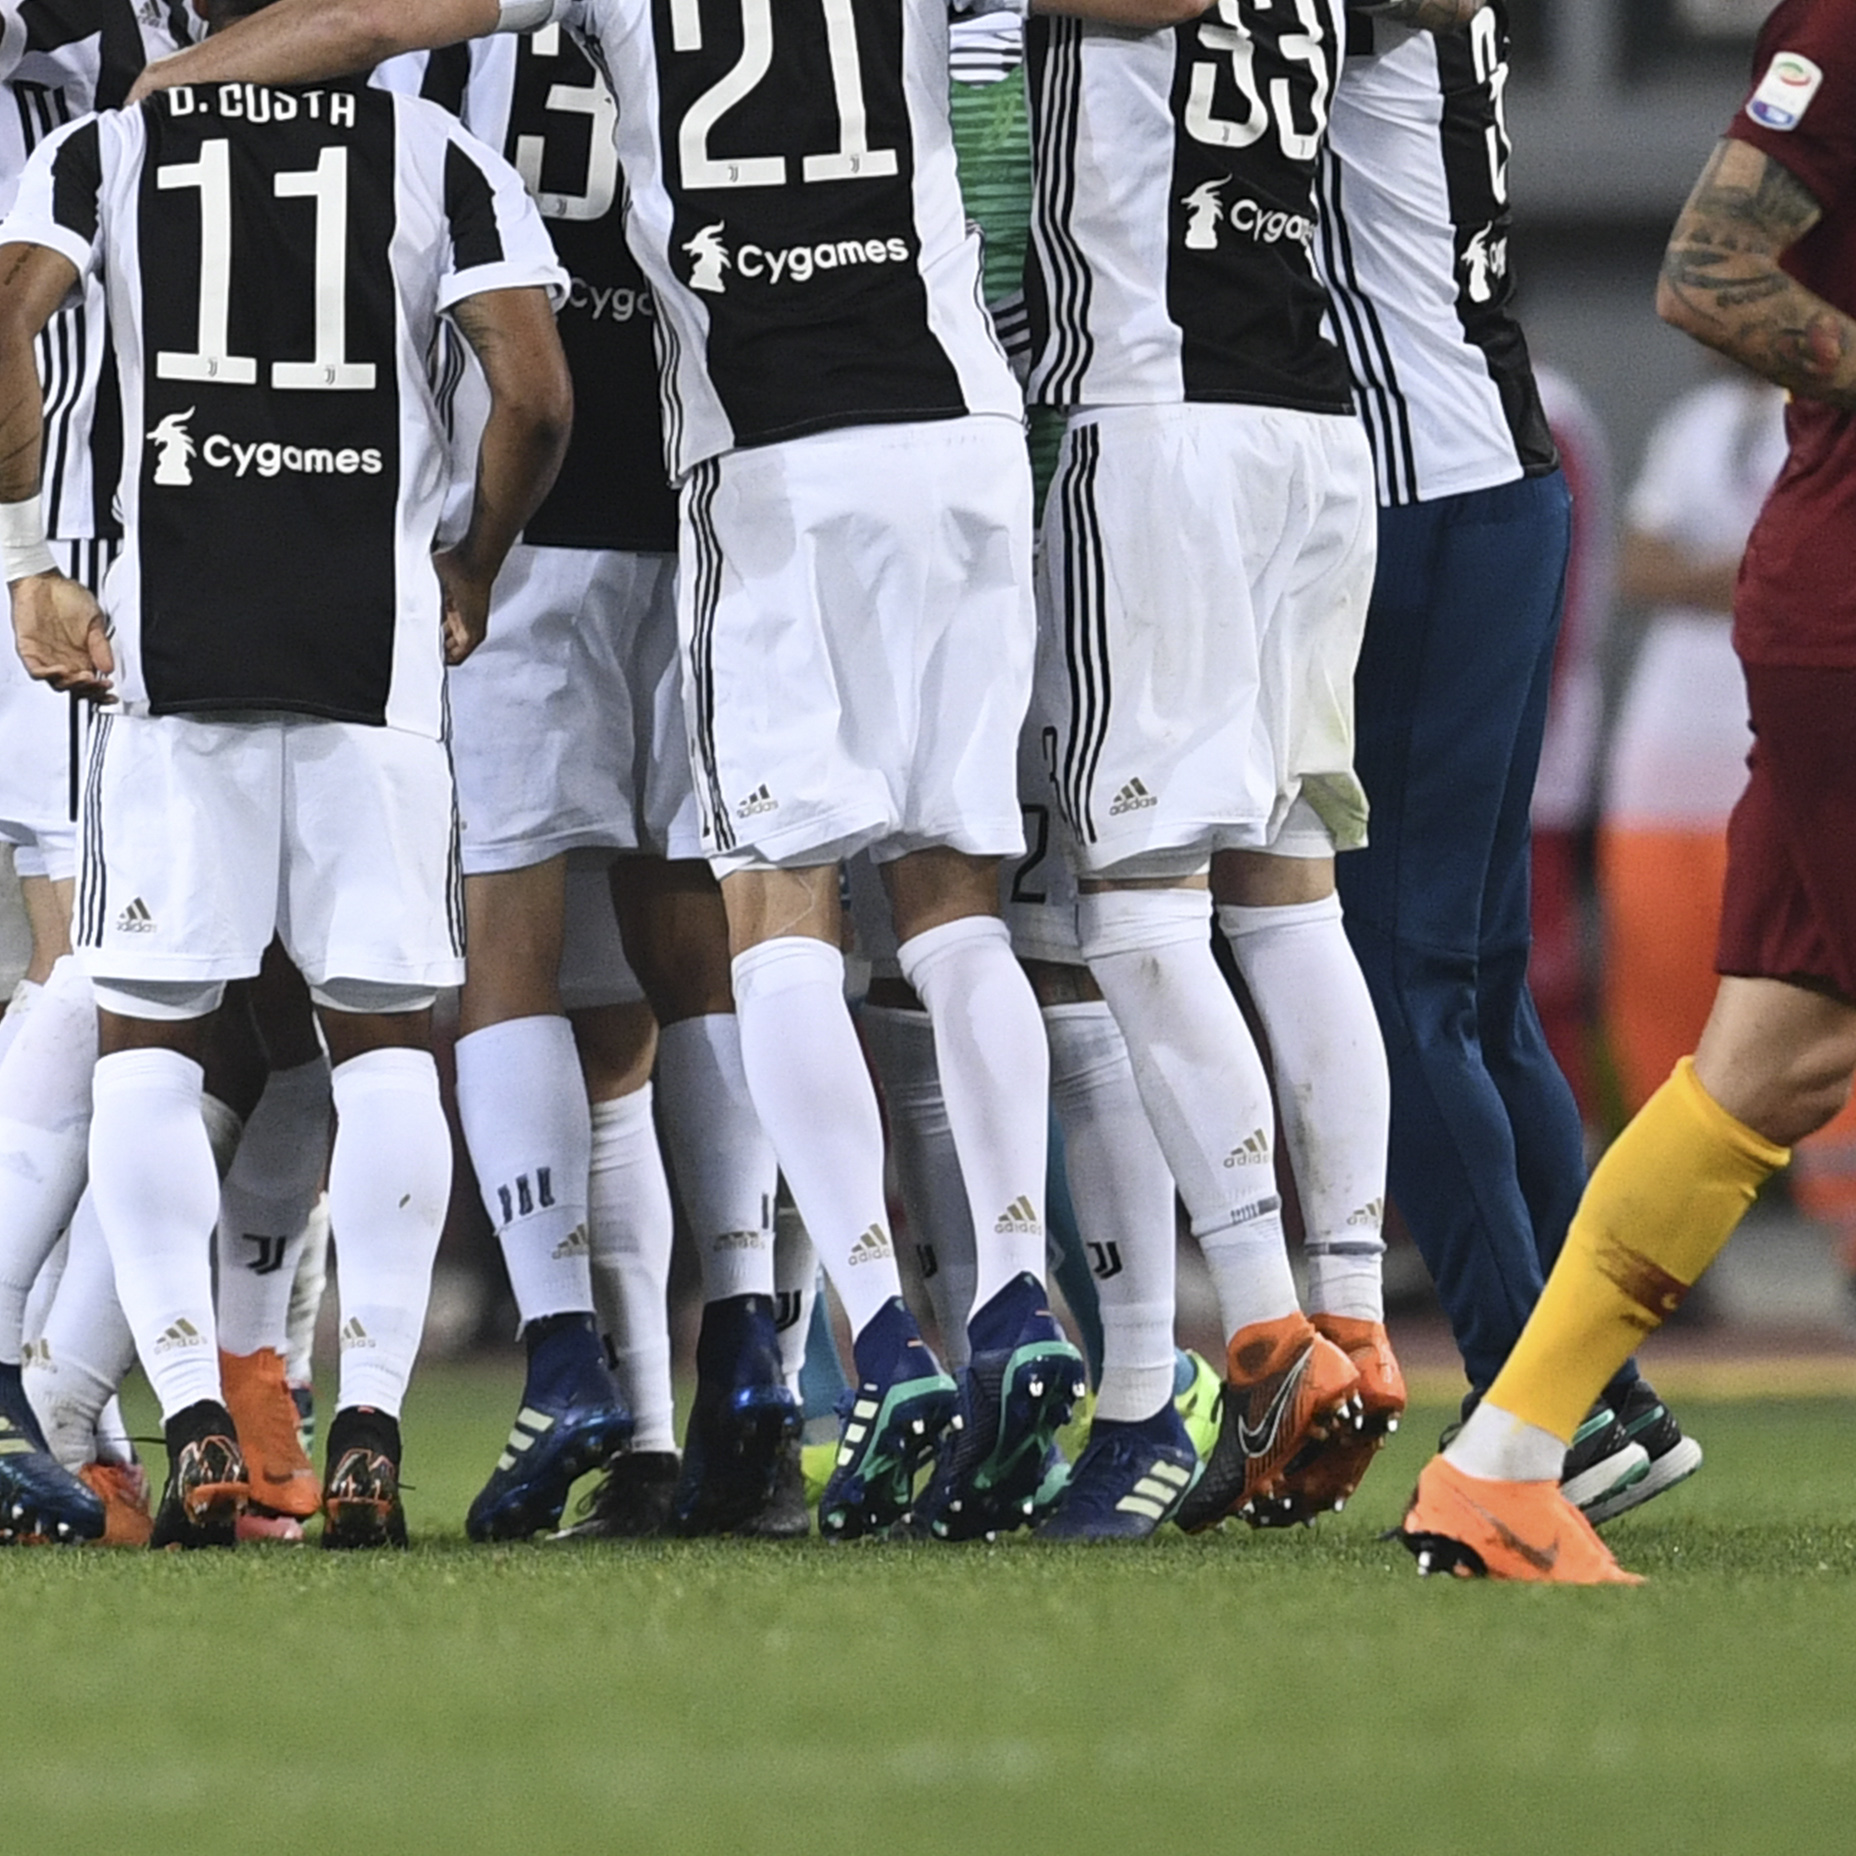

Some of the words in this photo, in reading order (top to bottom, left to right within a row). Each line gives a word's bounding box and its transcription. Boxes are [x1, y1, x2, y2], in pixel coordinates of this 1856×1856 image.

[157, 138, 376, 389] 11
[737, 238, 909, 284] Cygames
[203, 434, 383, 477] Cygames
